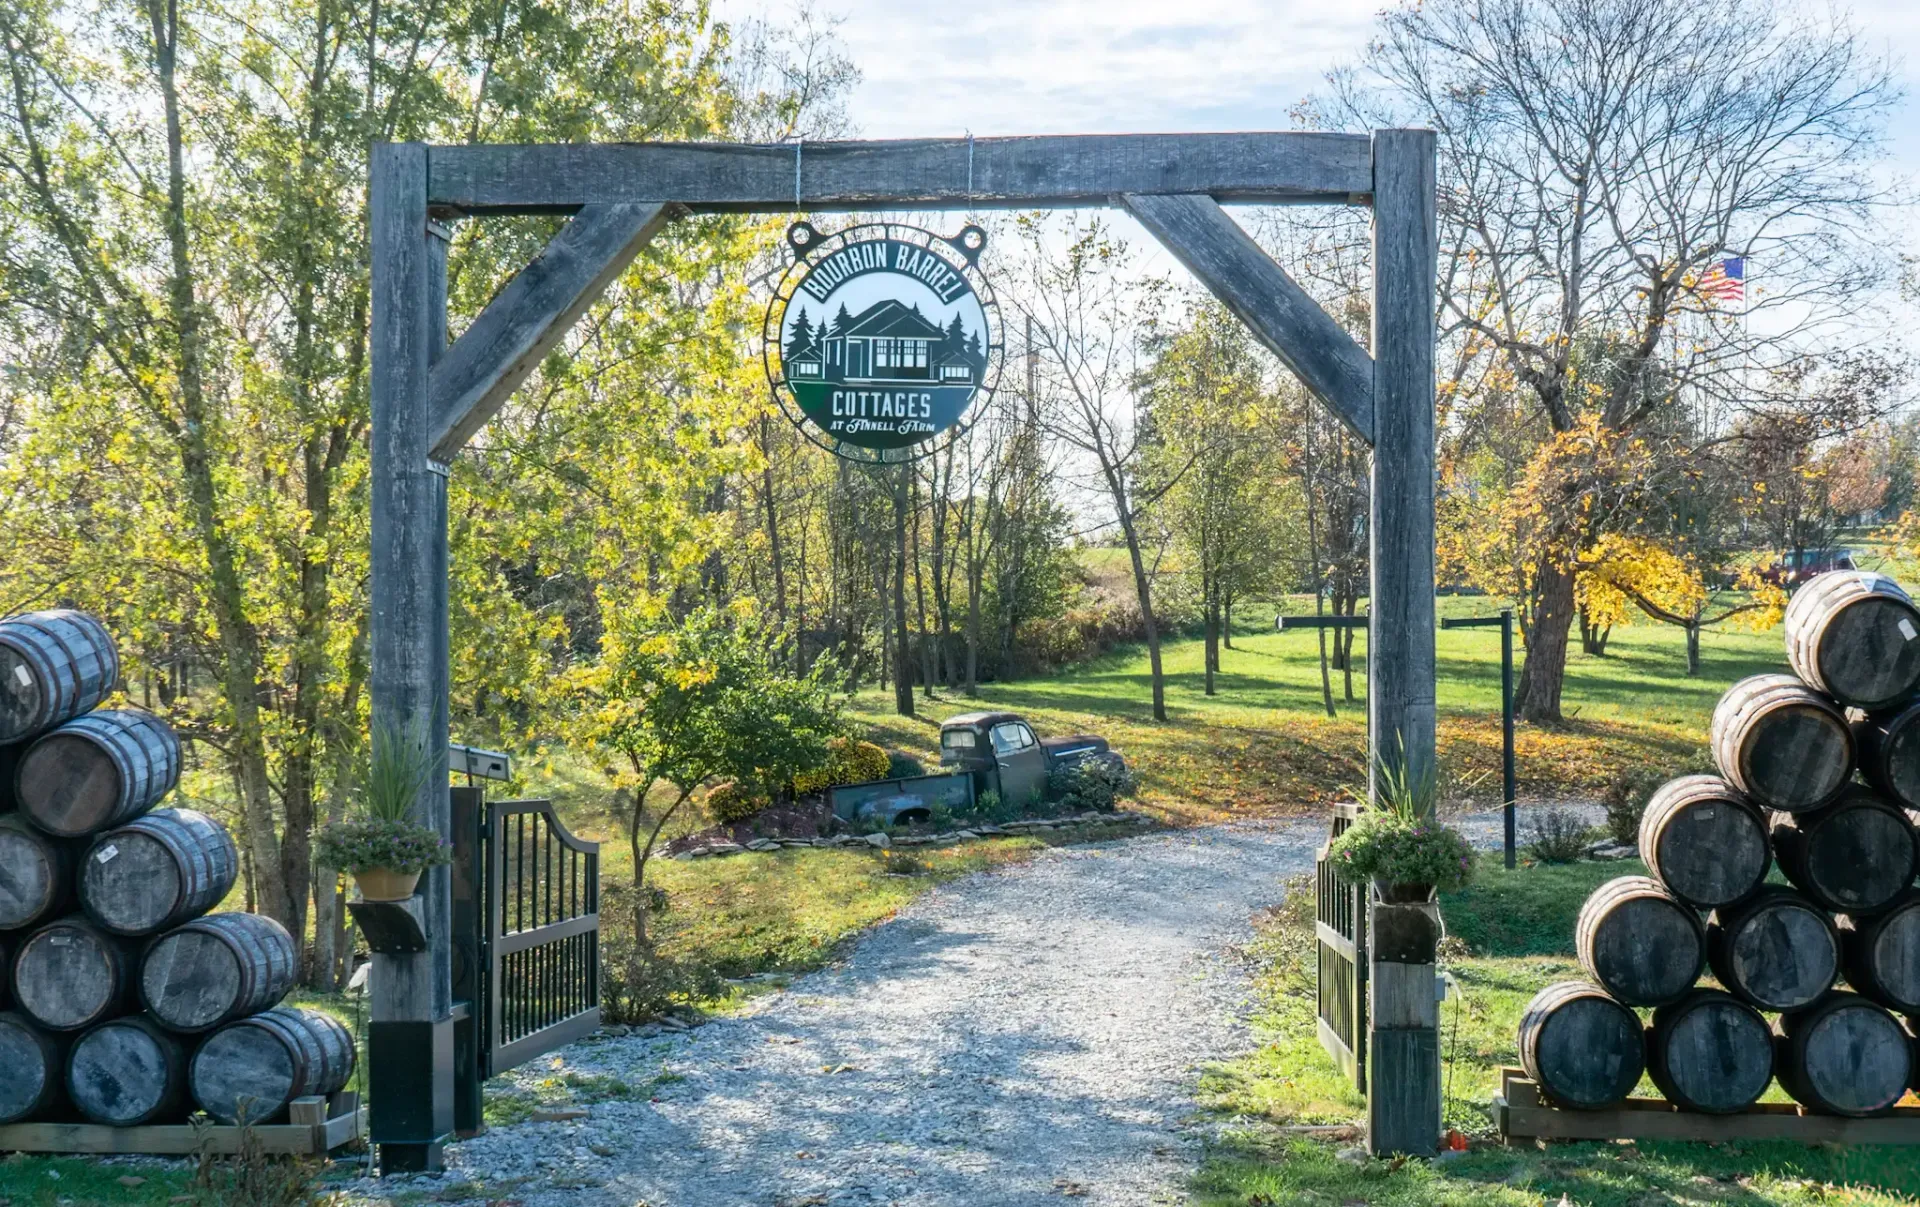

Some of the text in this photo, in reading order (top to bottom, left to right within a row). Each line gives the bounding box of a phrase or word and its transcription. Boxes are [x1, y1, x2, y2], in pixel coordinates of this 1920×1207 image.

[804, 243, 962, 302] BOURBON BARREL
[832, 391, 931, 418] COTTAGES
[830, 421, 844, 430] AT
[898, 420, 936, 434] FARM
